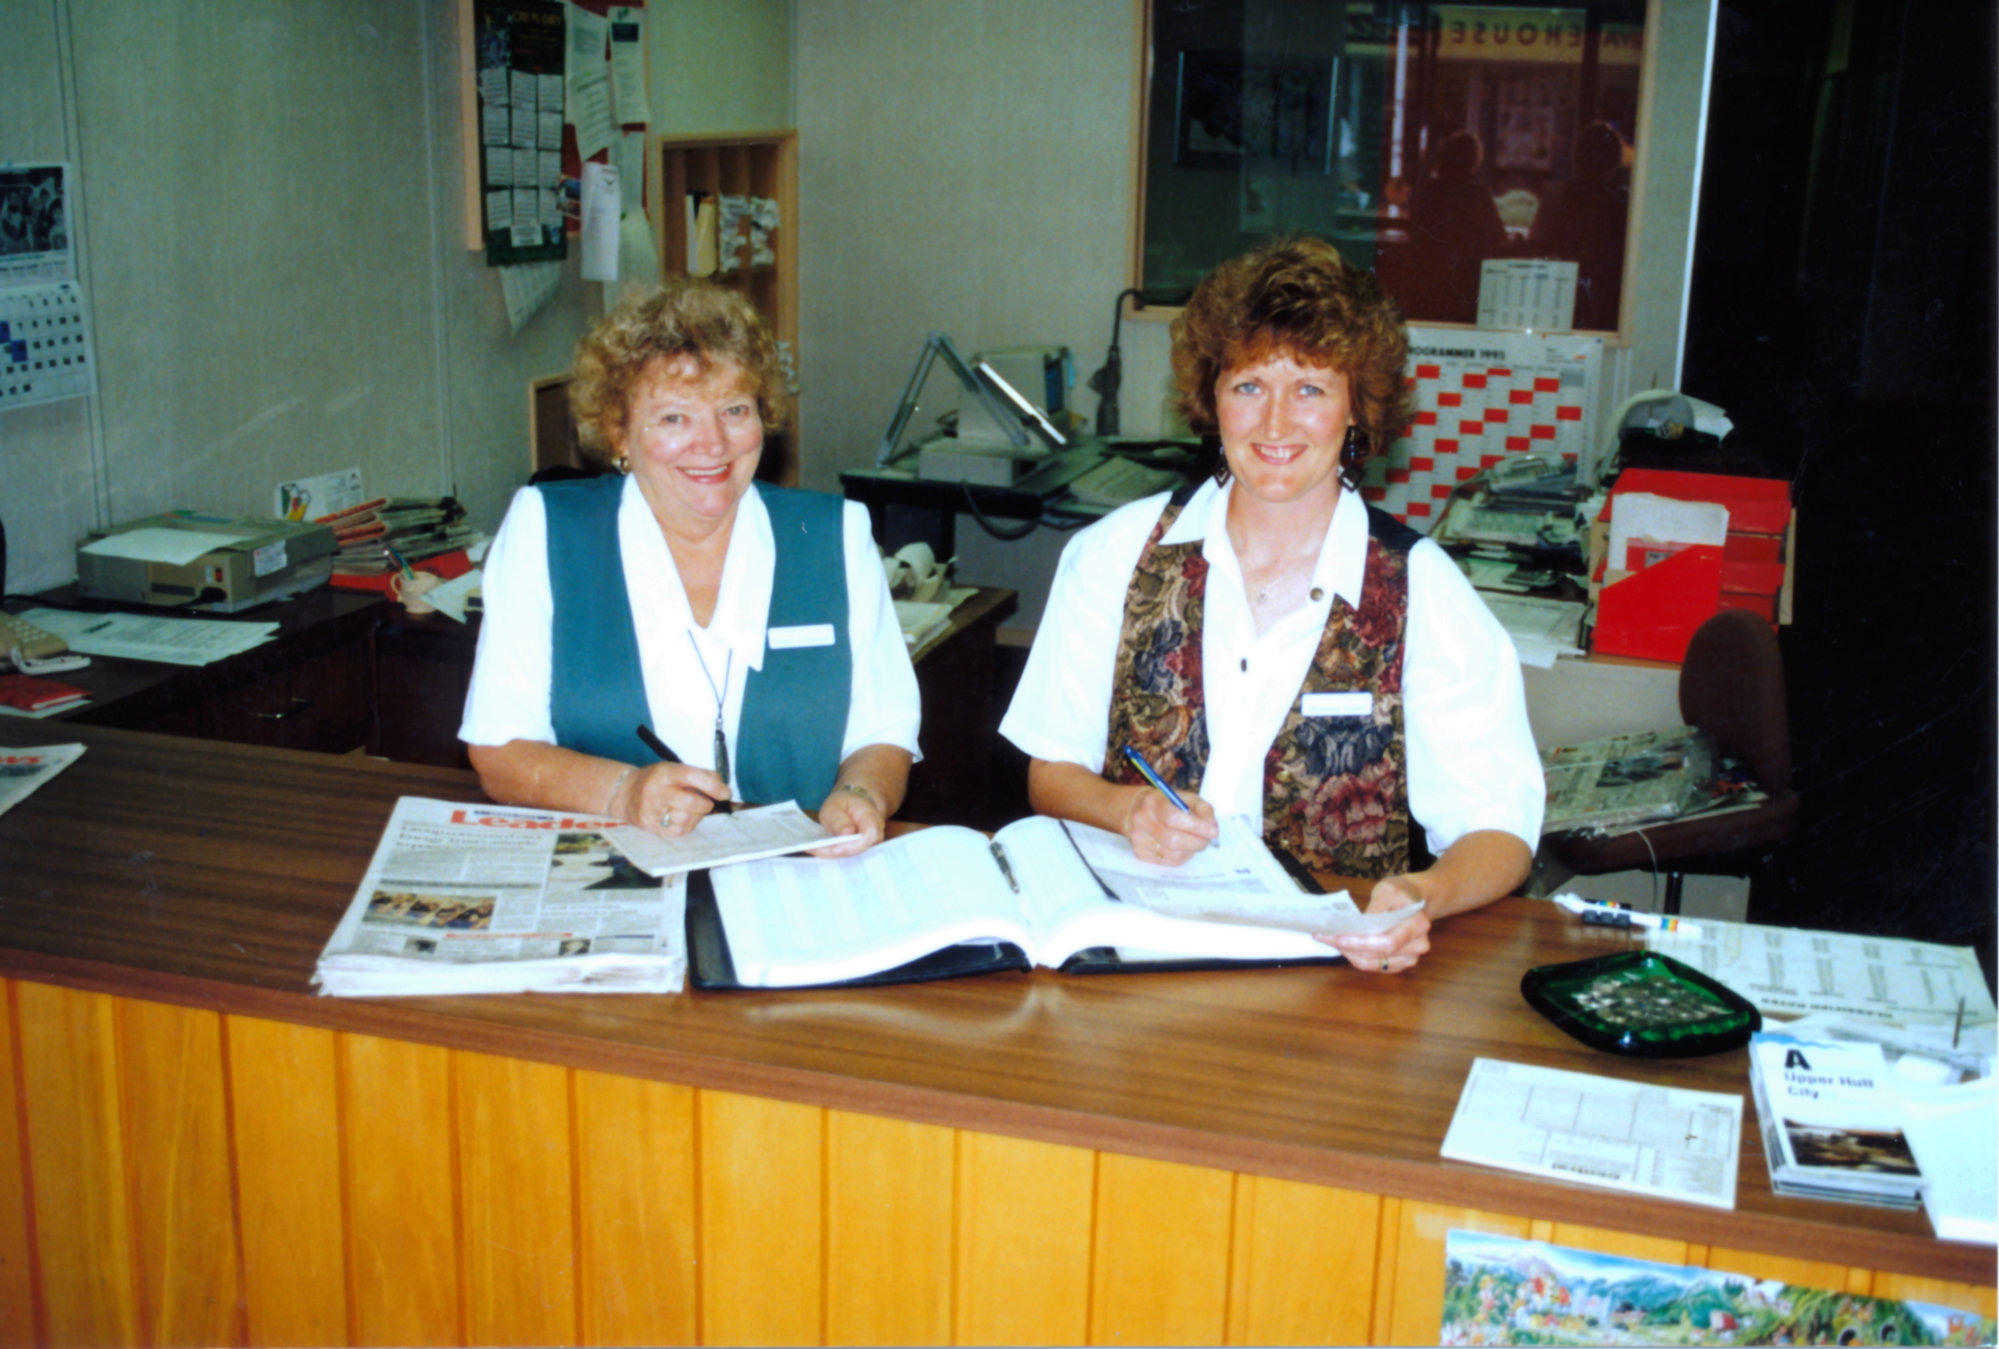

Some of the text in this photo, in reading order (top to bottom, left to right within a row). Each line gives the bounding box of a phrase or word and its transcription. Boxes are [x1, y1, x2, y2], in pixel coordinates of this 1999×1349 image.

[449, 809, 629, 830] Leader
[1784, 1071, 1875, 1089] Upper Hutt
[1786, 1086, 1820, 1100] City
